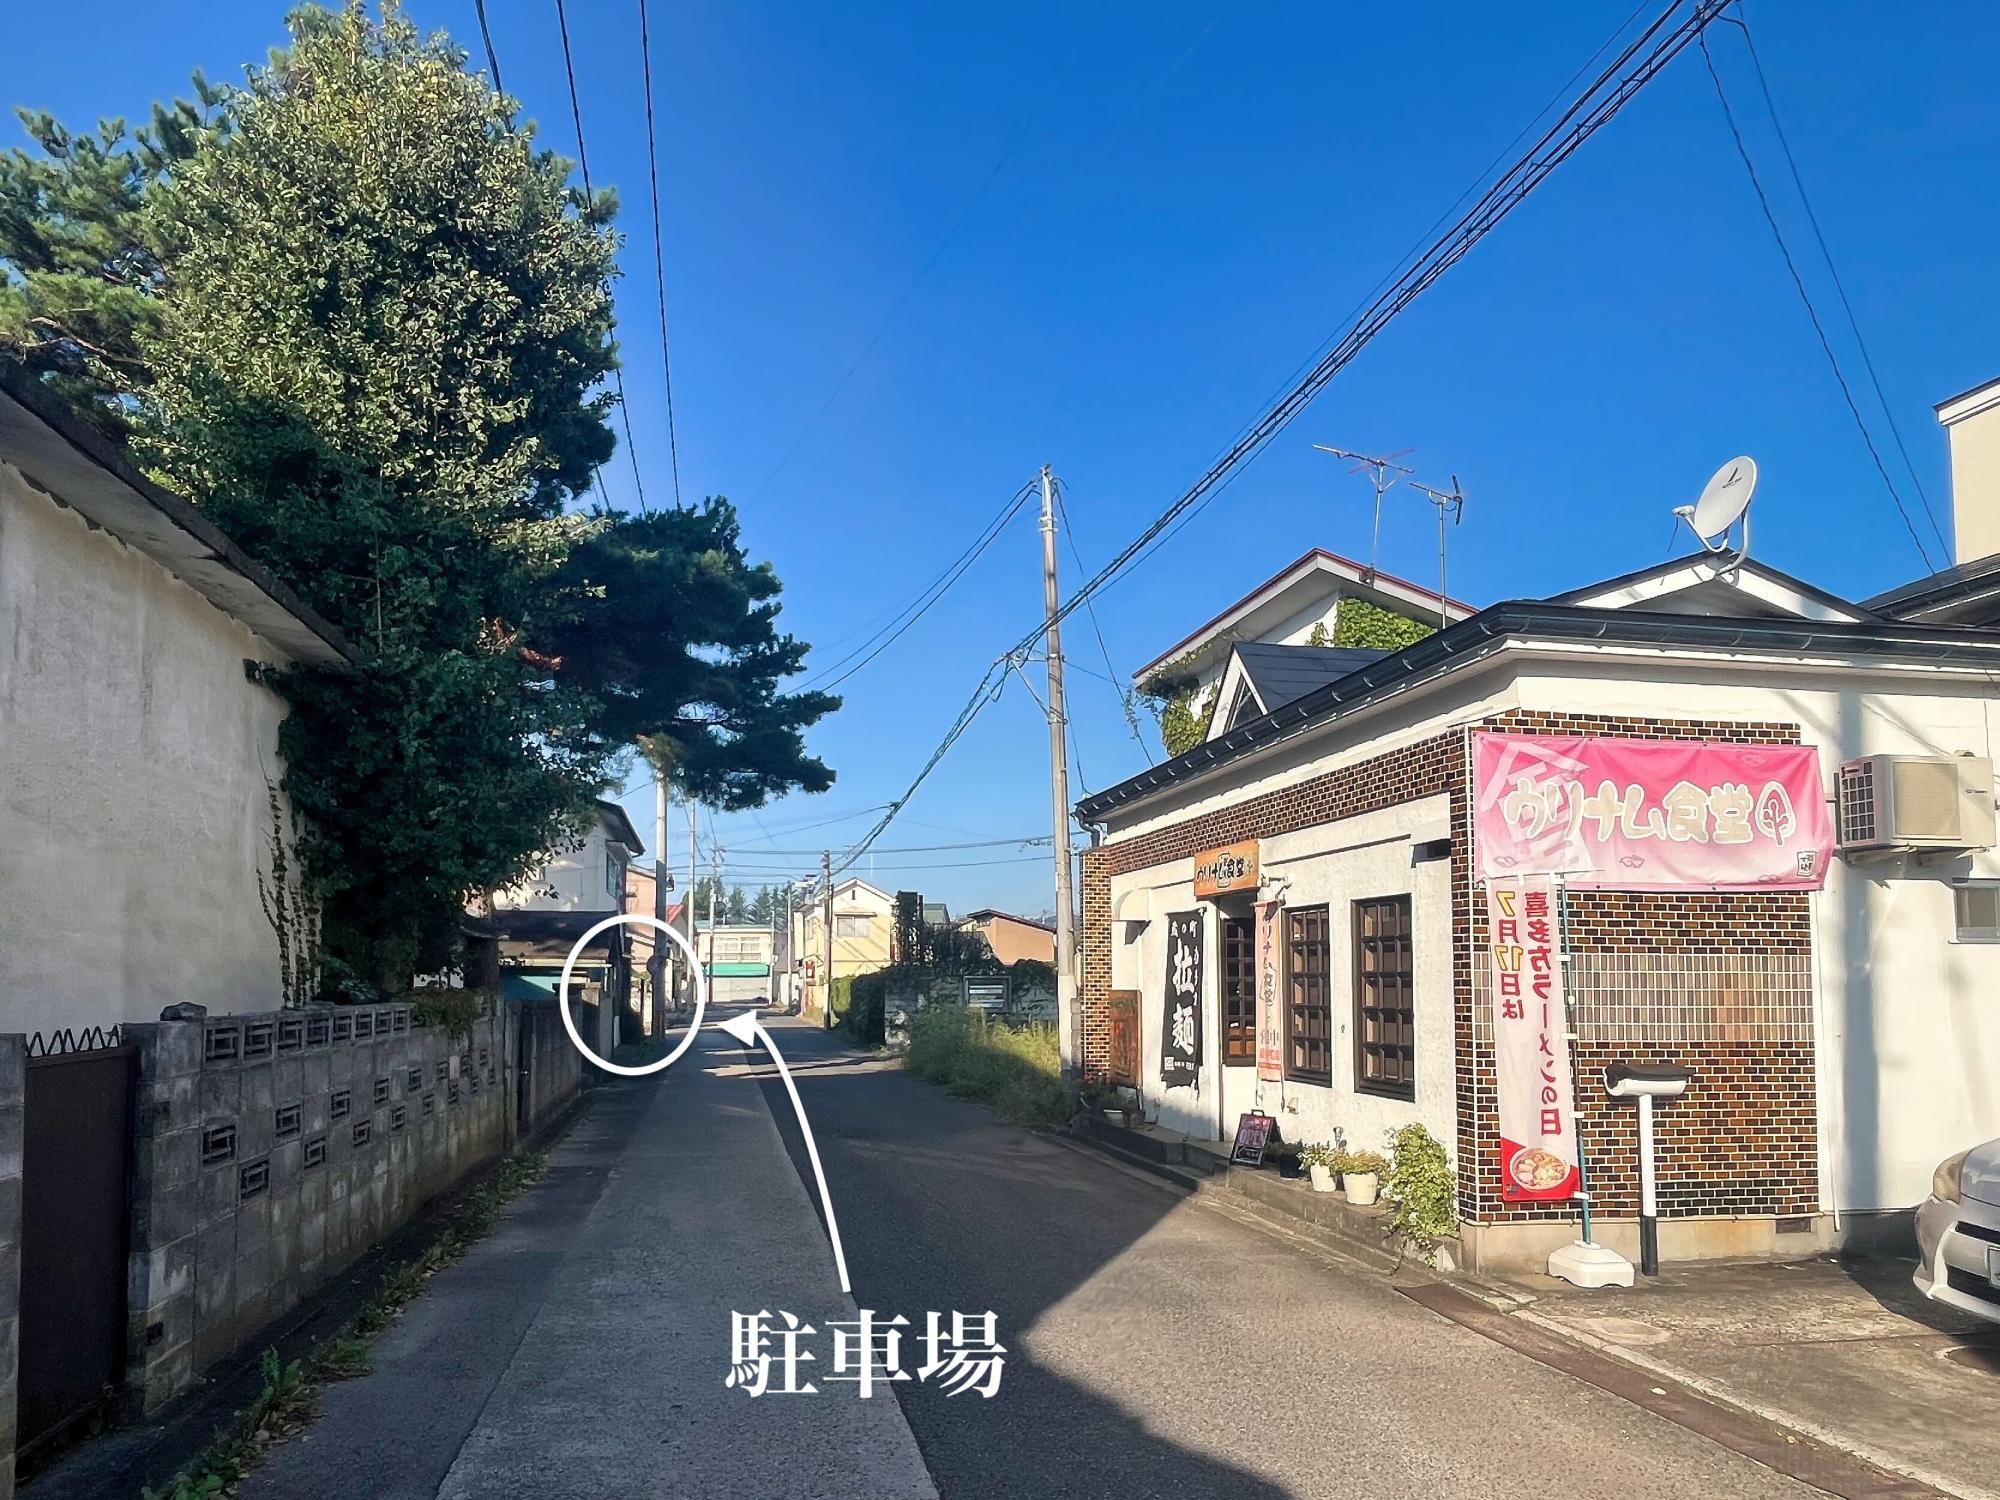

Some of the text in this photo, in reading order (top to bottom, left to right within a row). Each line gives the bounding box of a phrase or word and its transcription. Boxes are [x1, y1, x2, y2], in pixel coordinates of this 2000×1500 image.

[1504, 778, 1754, 845] ウリナム食堂
[1172, 937, 1195, 1056] 拉麺
